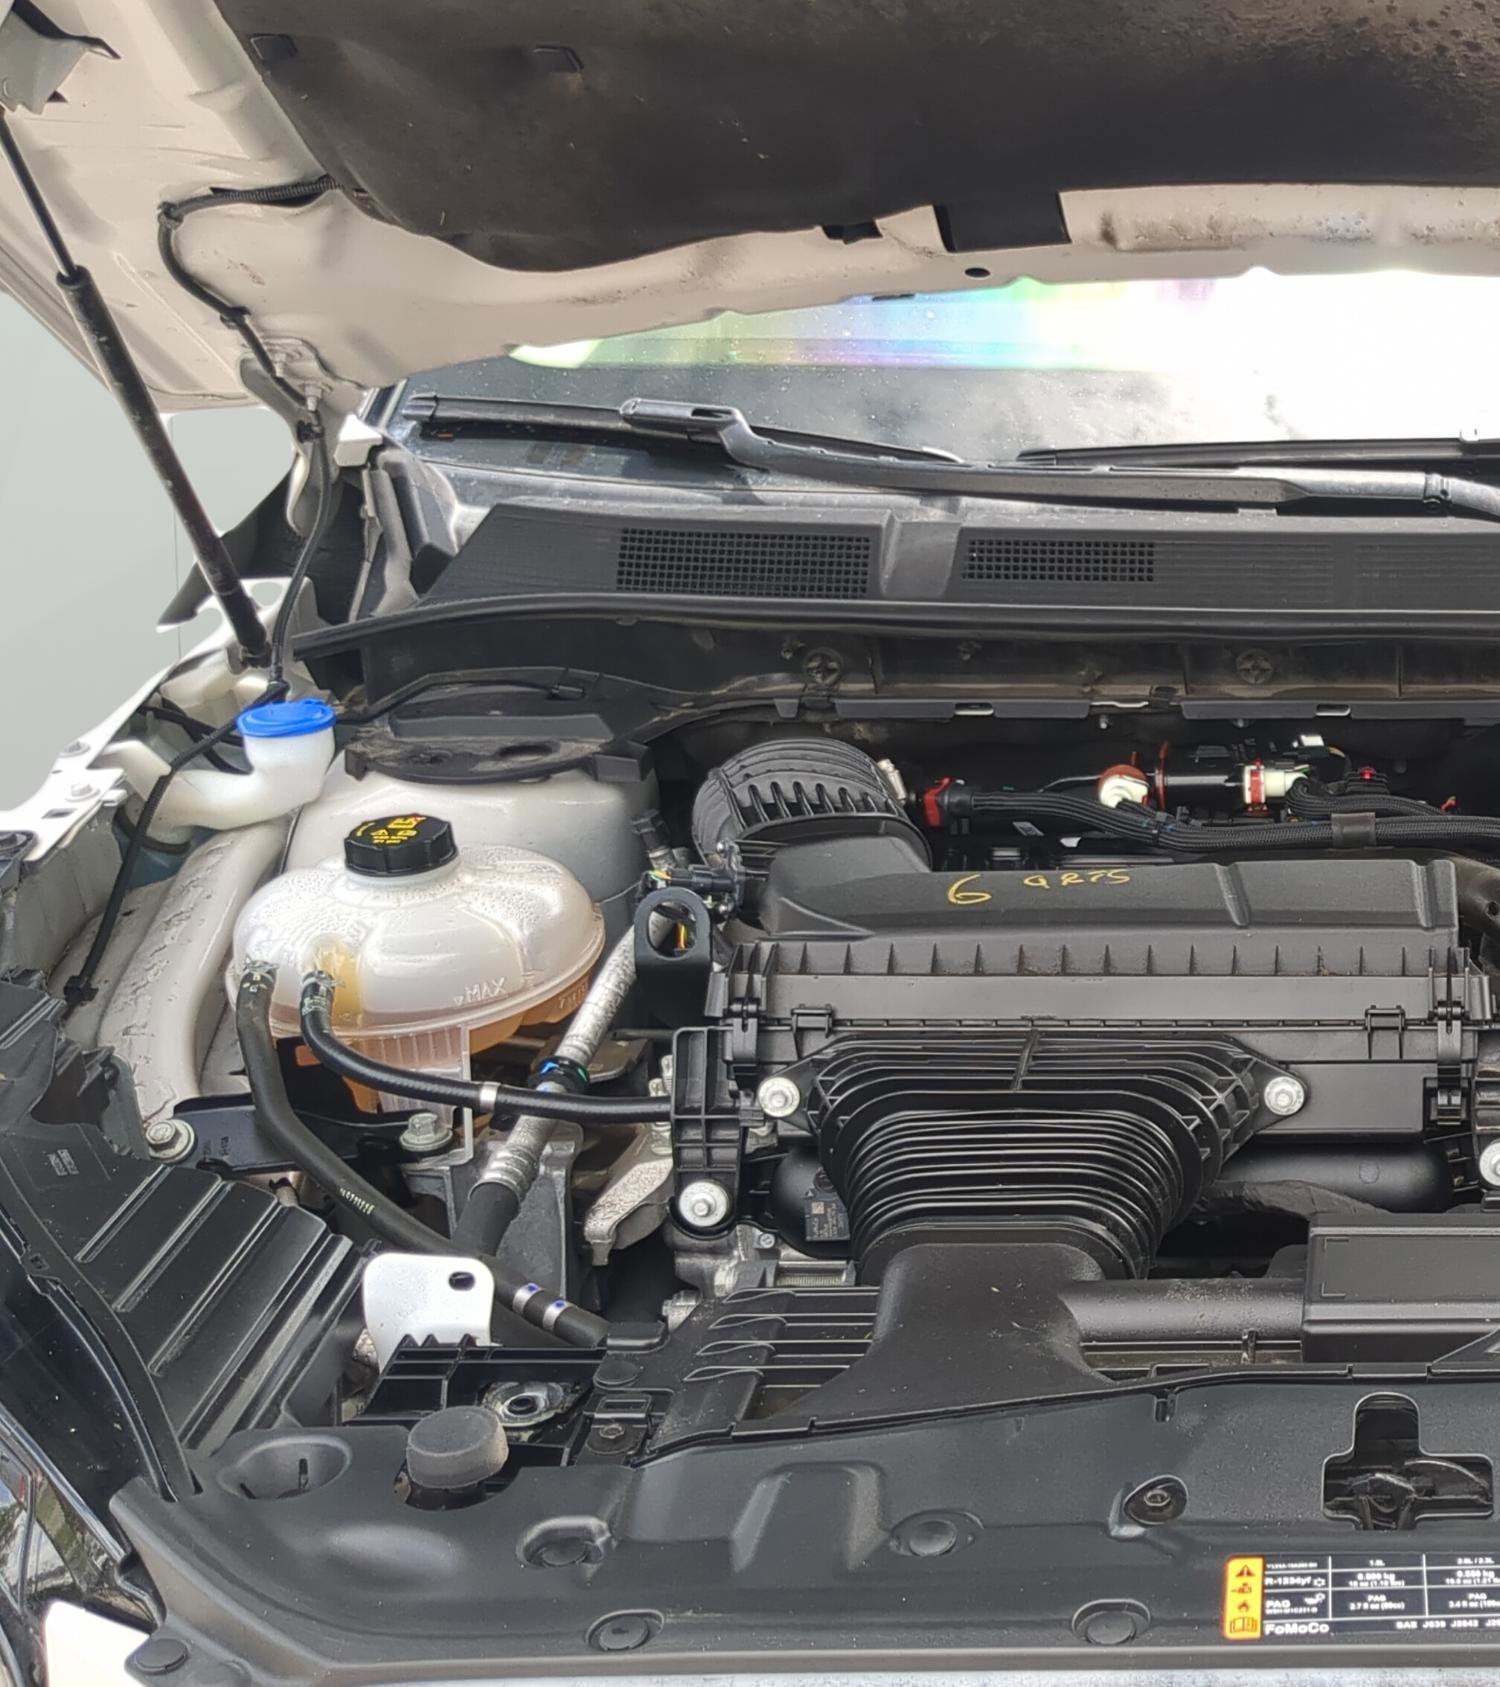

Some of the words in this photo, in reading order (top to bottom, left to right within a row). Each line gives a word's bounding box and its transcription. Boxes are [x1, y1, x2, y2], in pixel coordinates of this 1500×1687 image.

[947, 874, 992, 904] 6
[464, 977, 507, 1002] MAX
[1264, 1576, 1312, 1586] R-1234yf
[1264, 1622, 1330, 1635] FoMoCo
